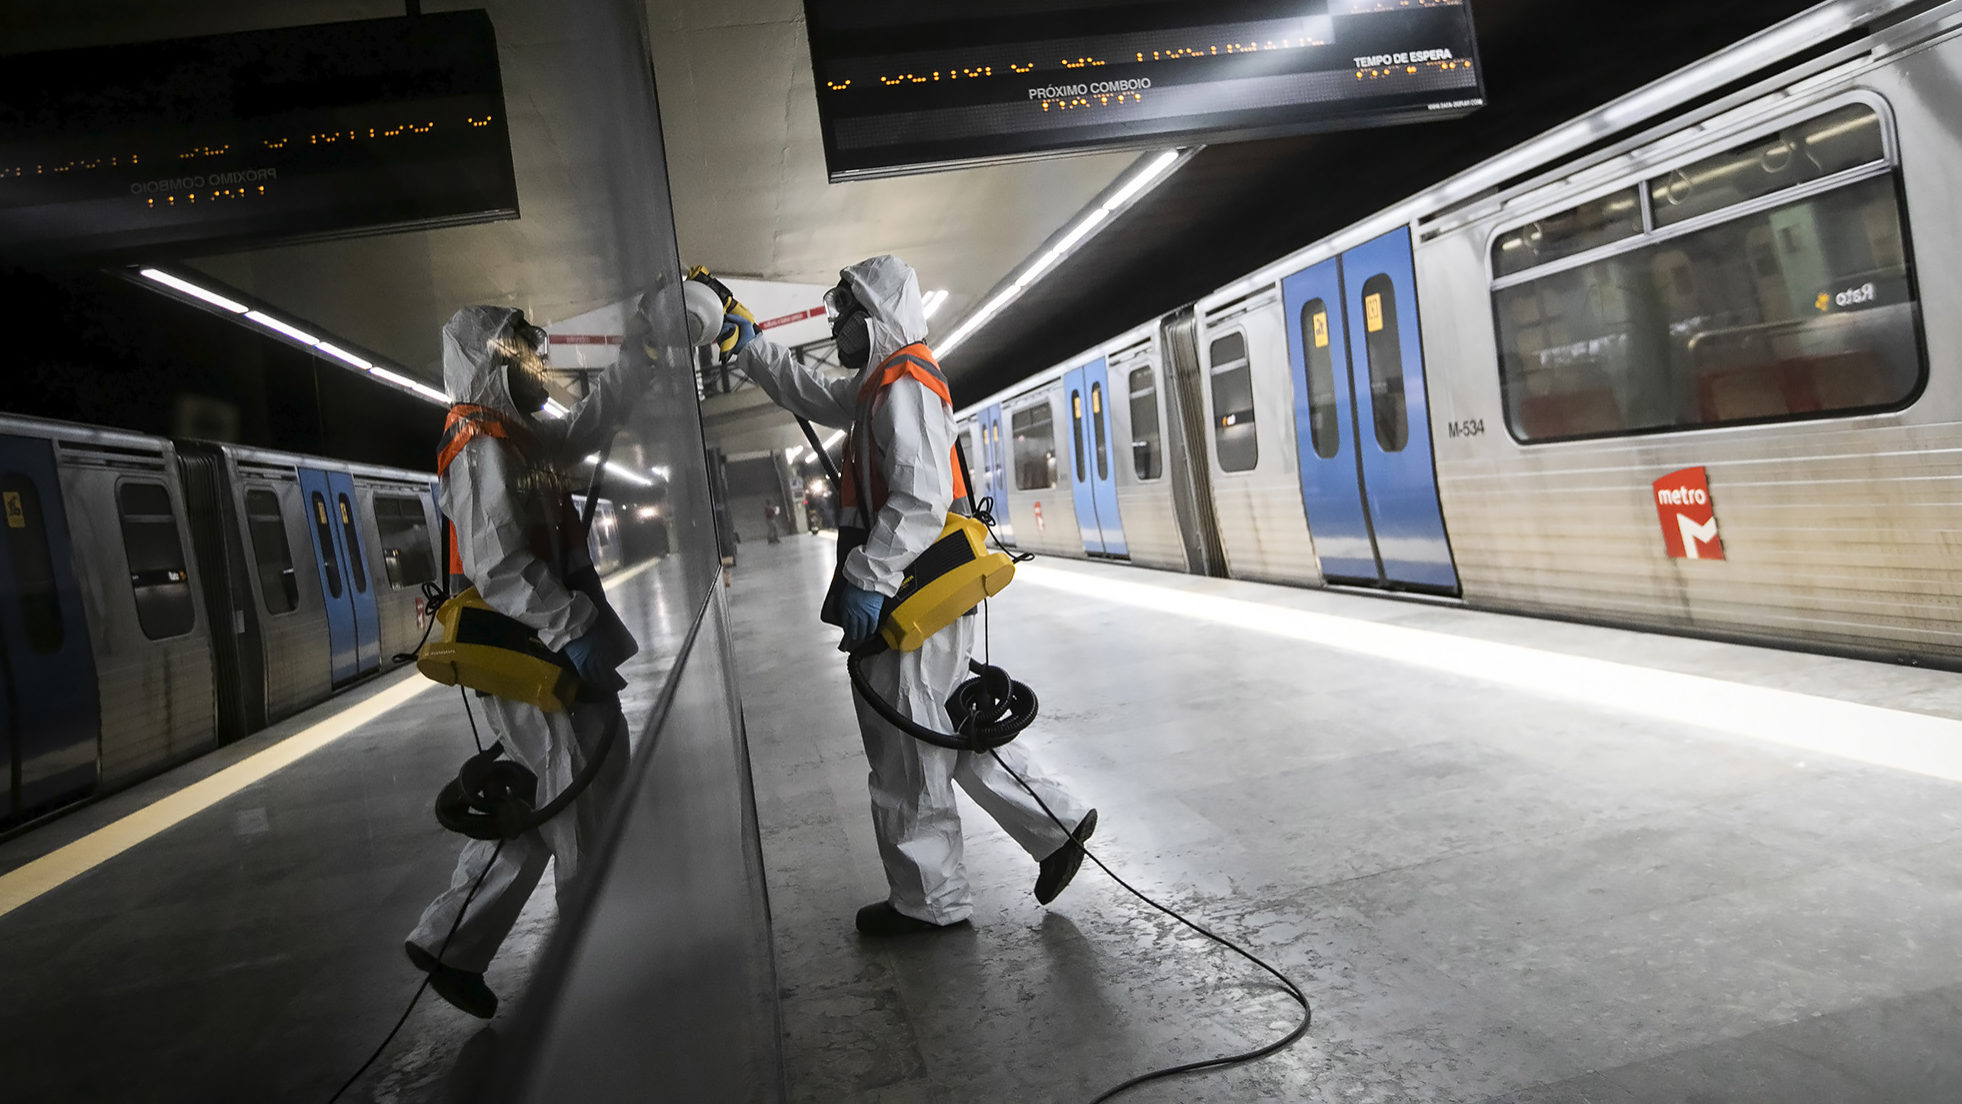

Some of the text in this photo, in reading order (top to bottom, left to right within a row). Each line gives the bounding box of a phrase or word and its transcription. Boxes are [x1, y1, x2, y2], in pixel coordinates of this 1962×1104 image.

[1353, 48, 1453, 68] TEMPO DE ESPERA
[1028, 77, 1152, 100] PRÓXIMO COMBOIO
[1448, 419, 1485, 438] M-534
[1657, 486, 1706, 505] metro
